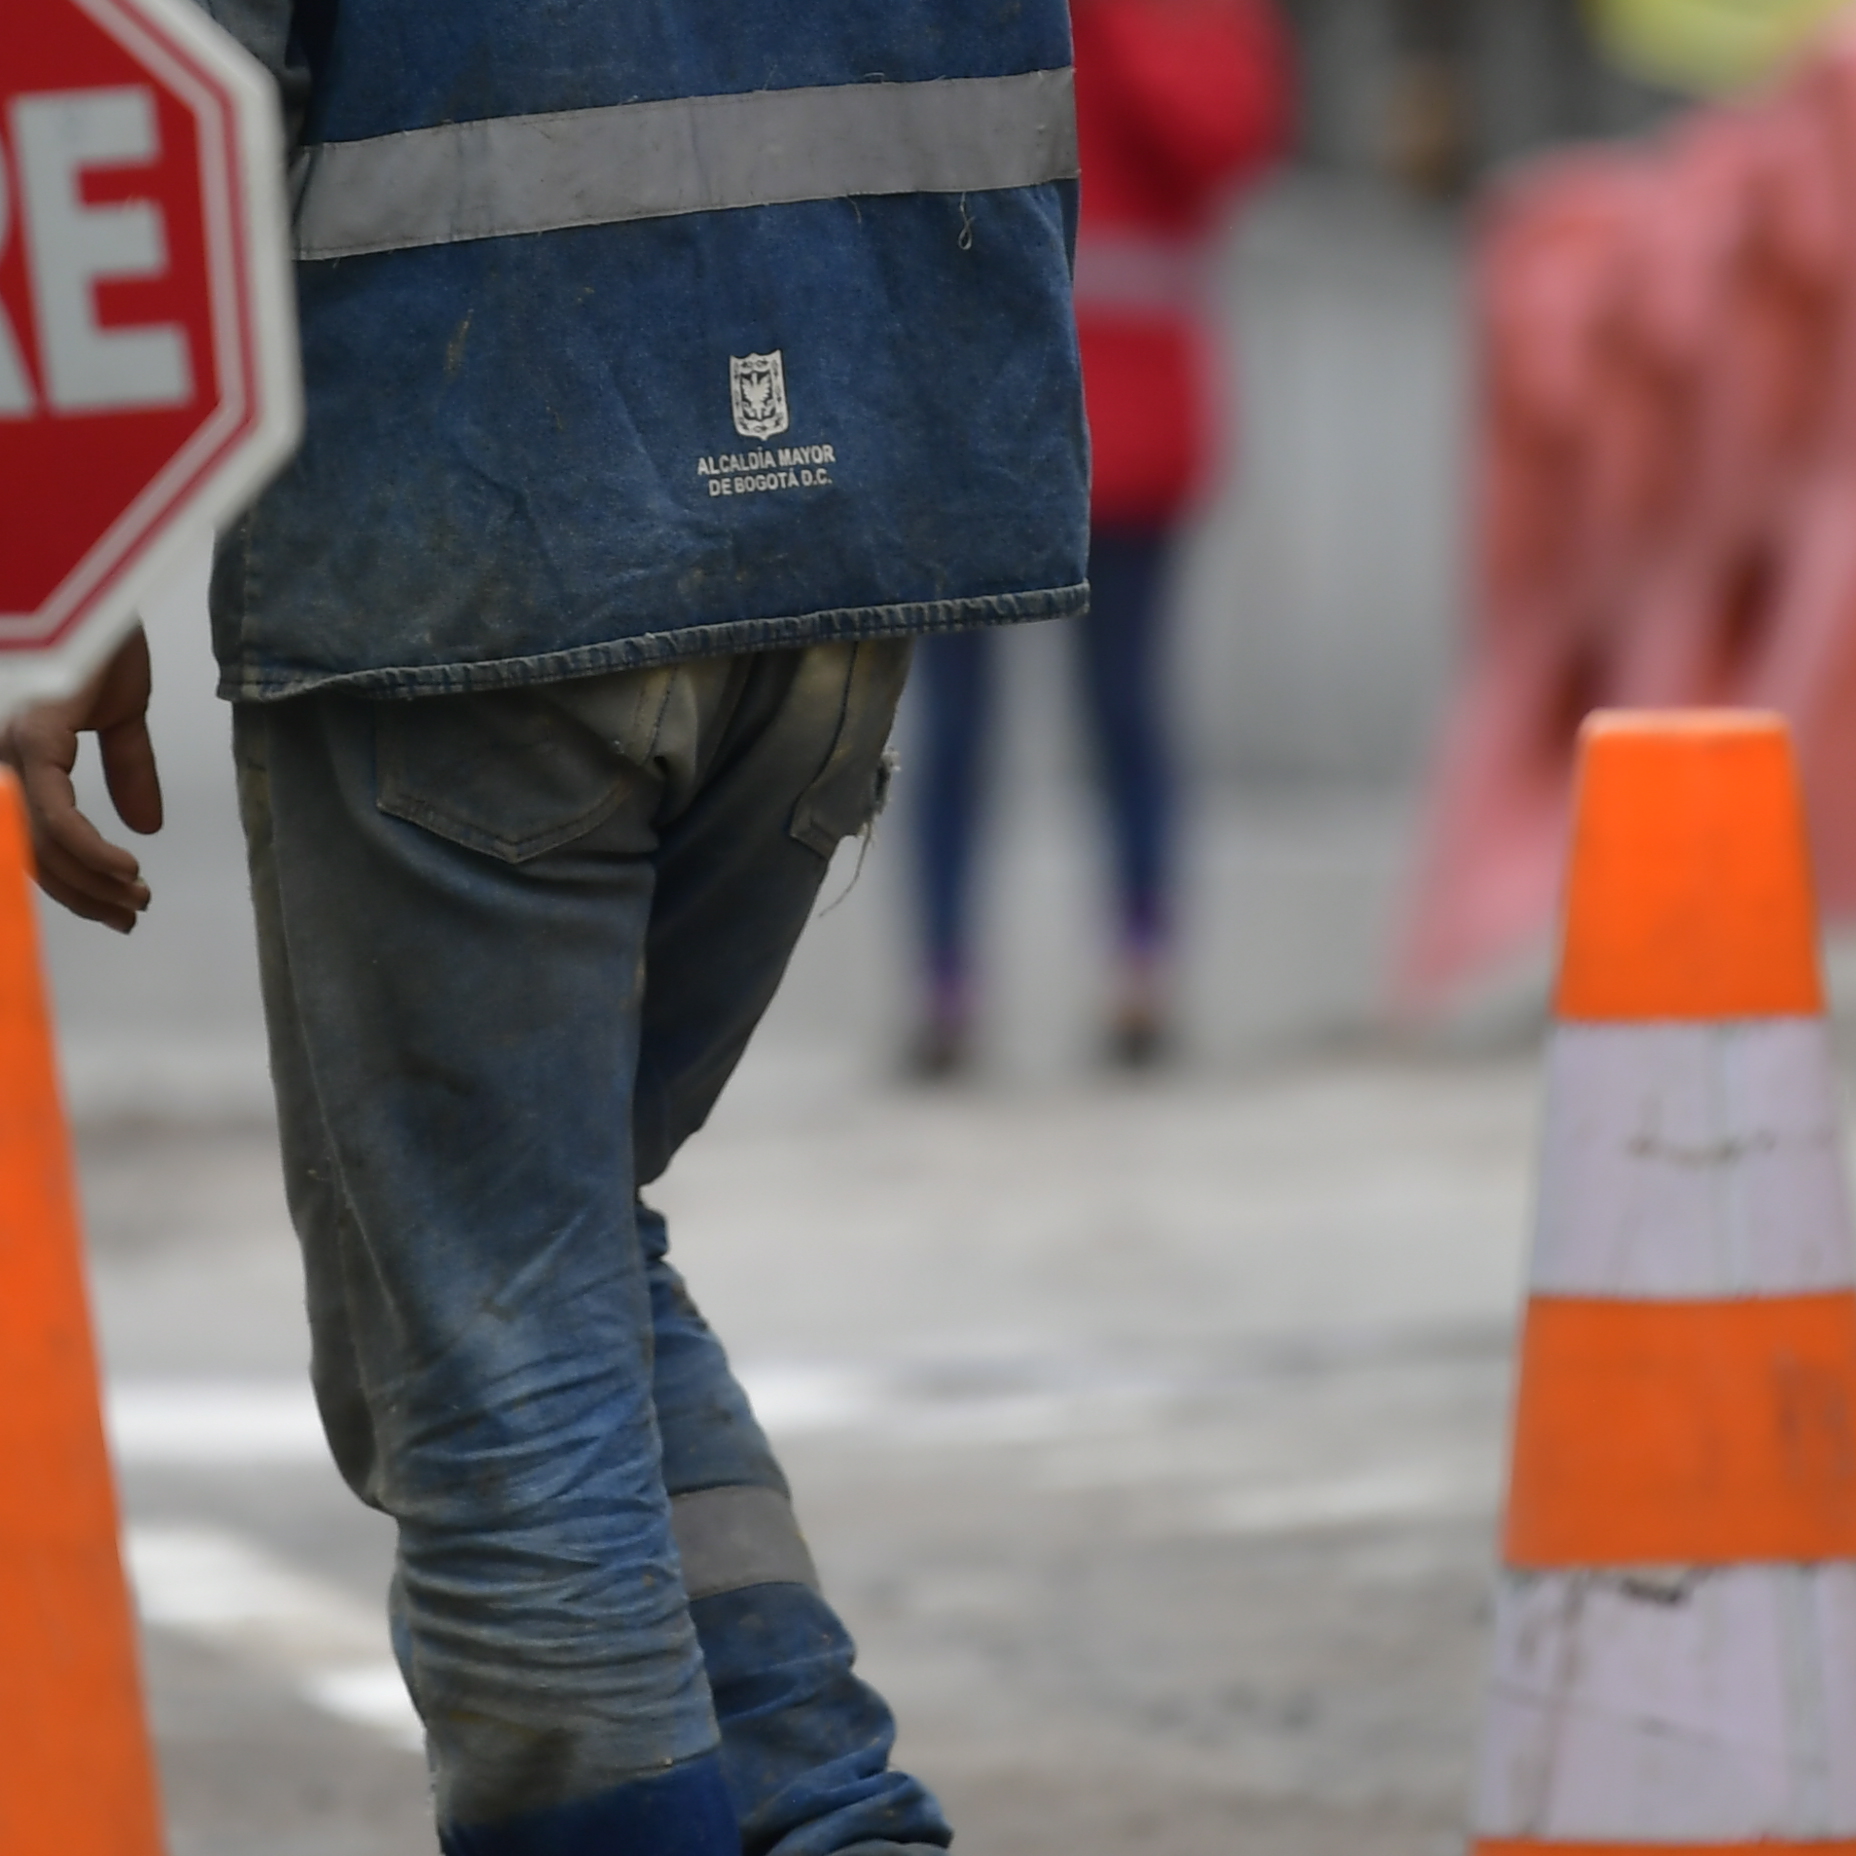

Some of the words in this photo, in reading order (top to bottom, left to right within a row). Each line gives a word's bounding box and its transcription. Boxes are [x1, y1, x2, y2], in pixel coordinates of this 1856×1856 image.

[697, 446, 777, 476] ALCALDÍA
[778, 444, 836, 467] MAYOR
[708, 477, 732, 497] DE
[734, 468, 800, 494] BOGOTÁ
[801, 469, 832, 487] D.C.
